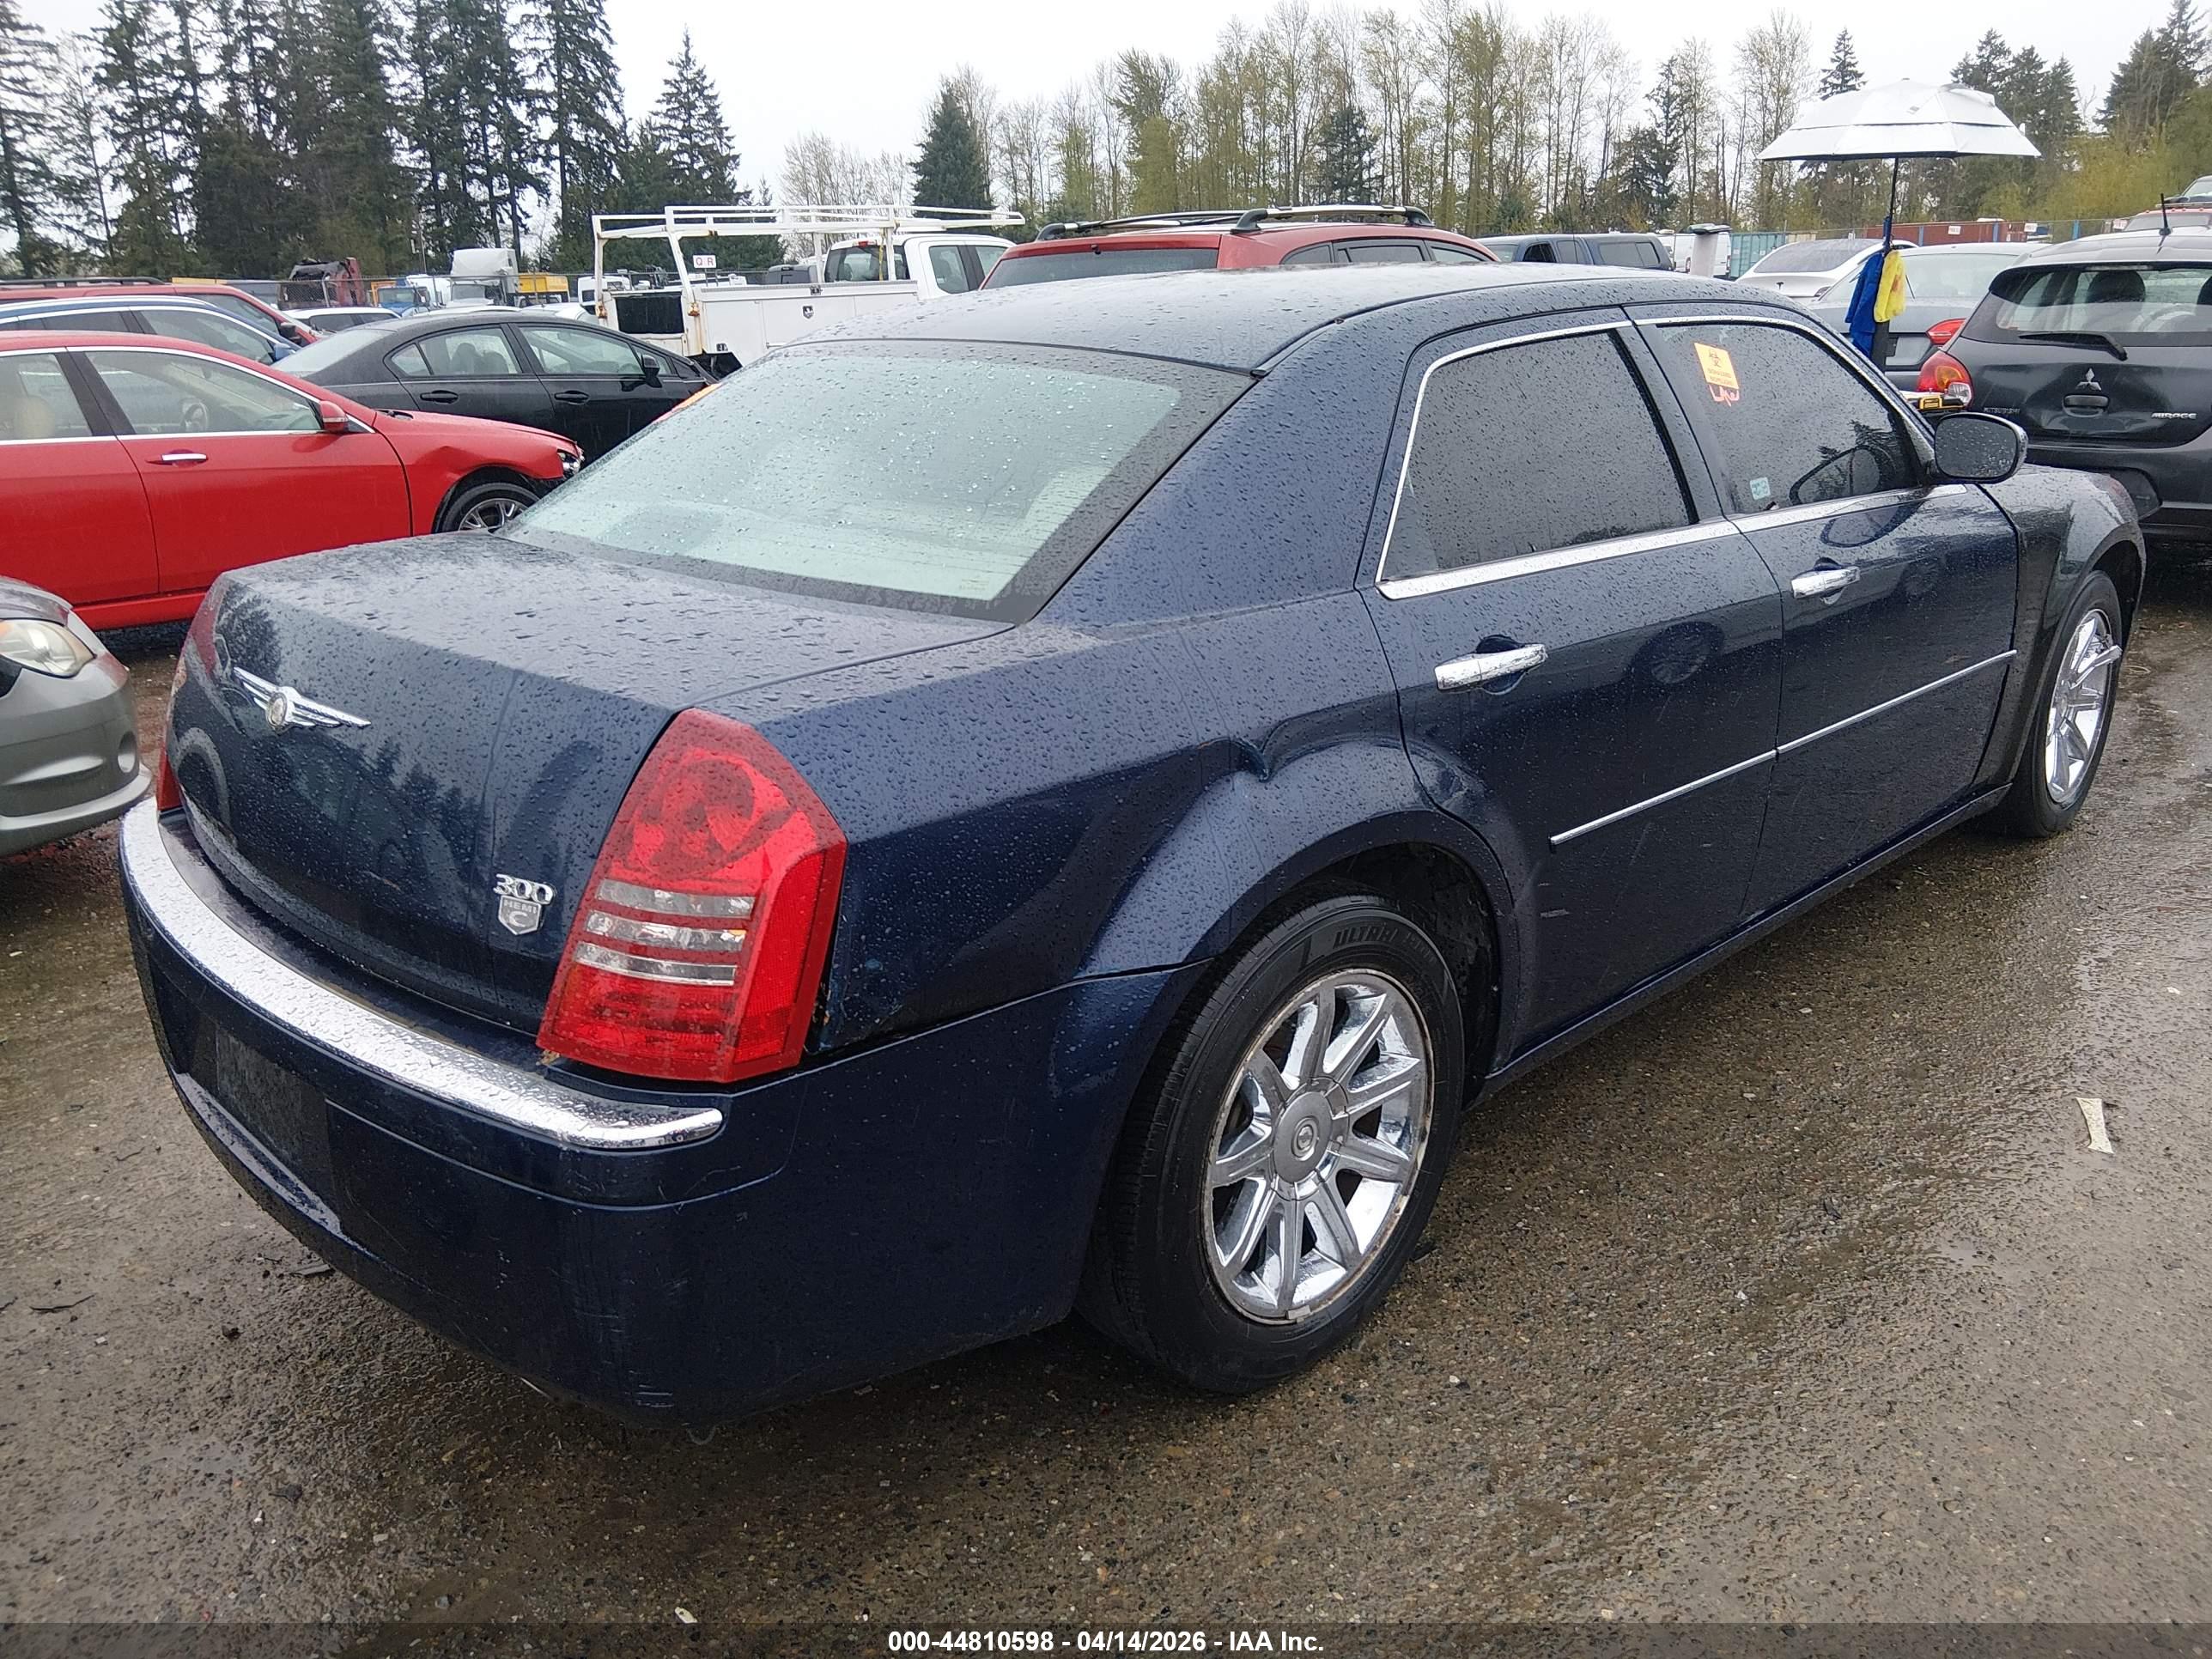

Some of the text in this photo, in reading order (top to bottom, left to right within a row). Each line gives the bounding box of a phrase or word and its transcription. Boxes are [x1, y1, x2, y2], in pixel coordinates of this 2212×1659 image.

[696, 257, 714, 265] Q R
[493, 873, 554, 905] 300
[503, 899, 537, 914] HEMI
[508, 910, 528, 927] C
